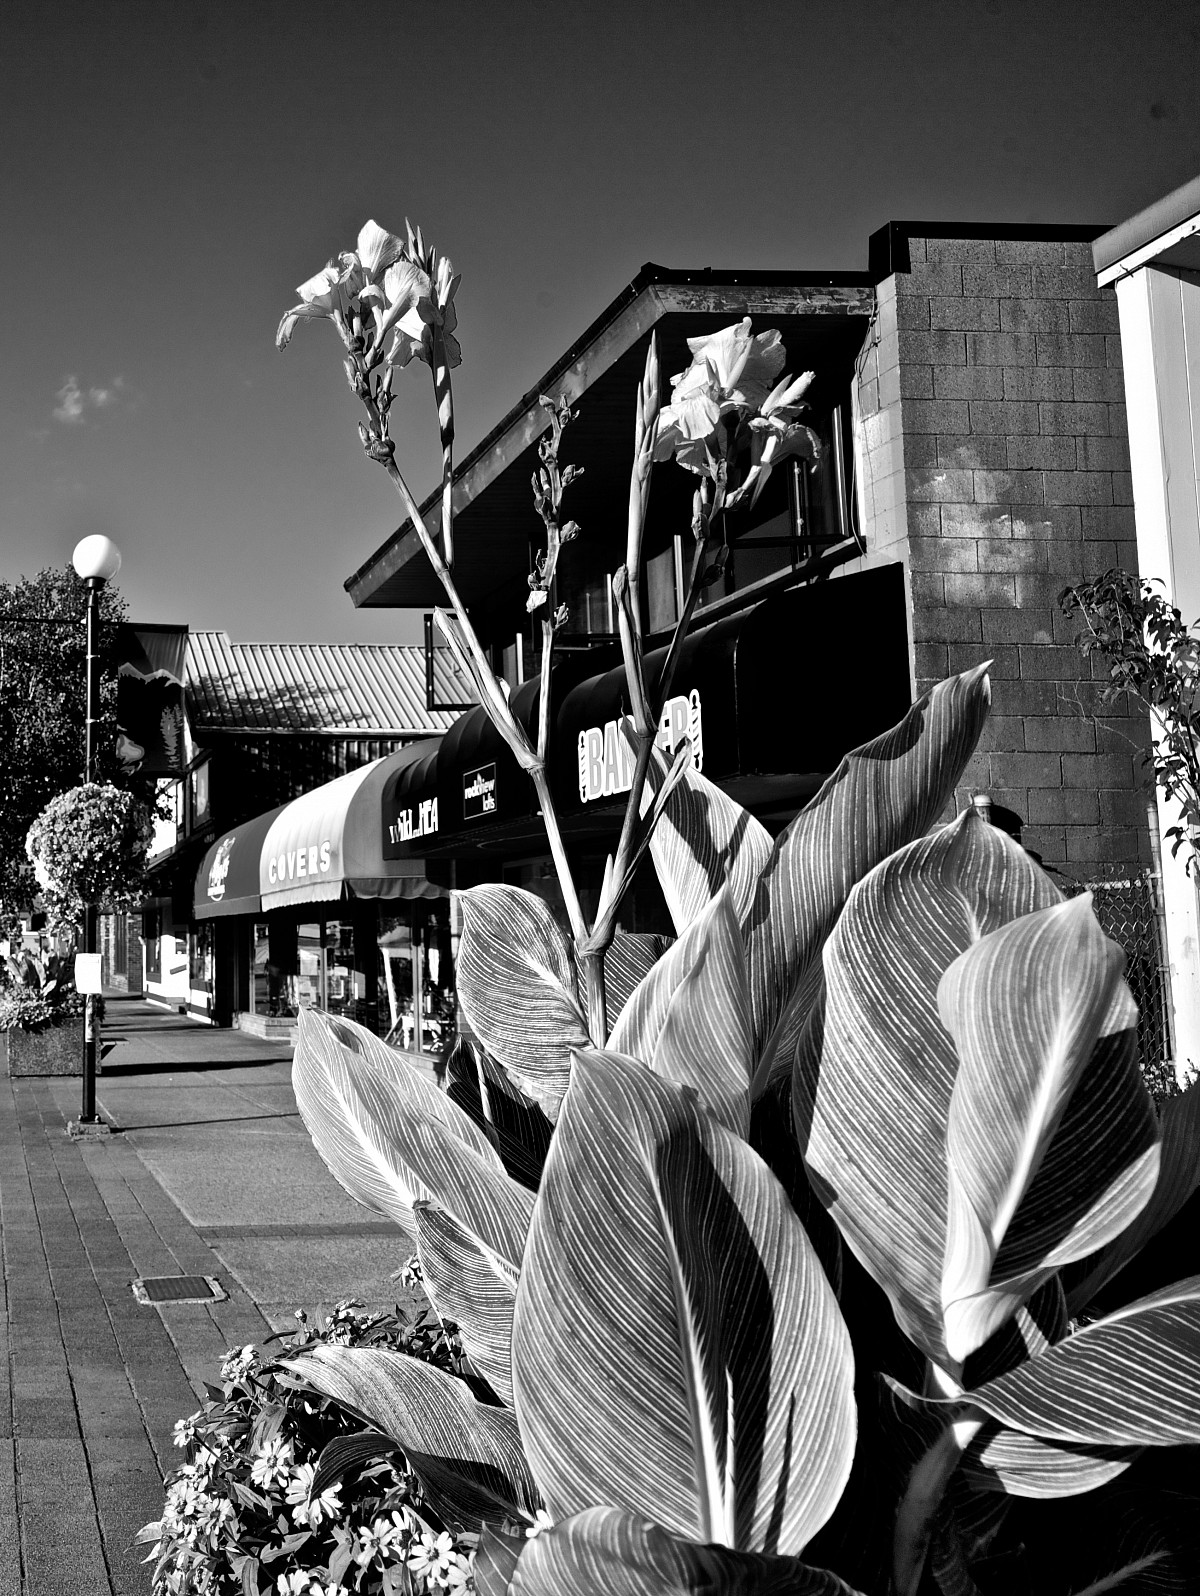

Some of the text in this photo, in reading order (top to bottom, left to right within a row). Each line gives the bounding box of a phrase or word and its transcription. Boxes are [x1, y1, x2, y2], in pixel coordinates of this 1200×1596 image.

[587, 700, 689, 795] BAER
[389, 808, 413, 844] Wild
[268, 840, 331, 884] COVERS
